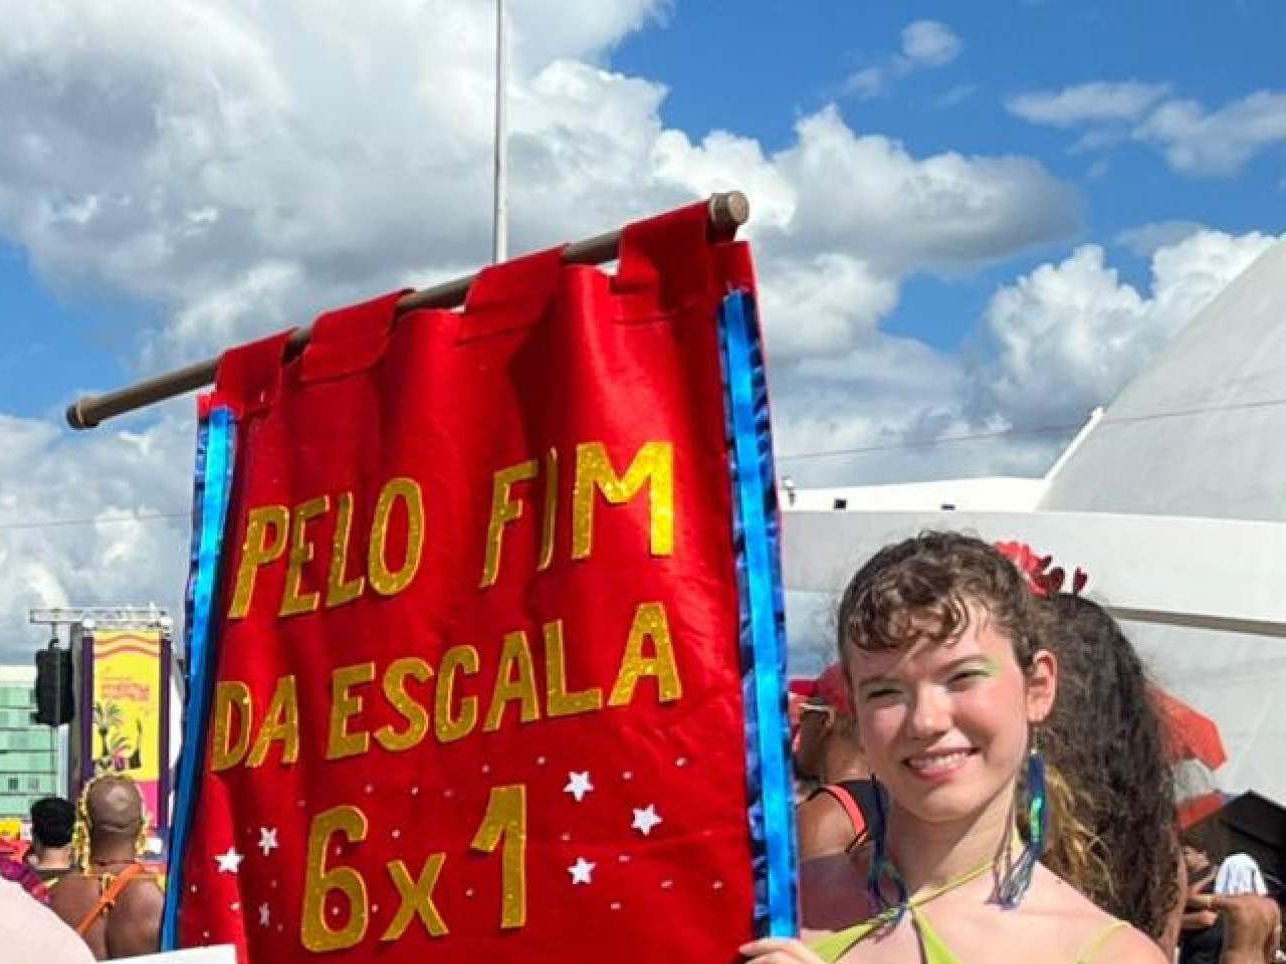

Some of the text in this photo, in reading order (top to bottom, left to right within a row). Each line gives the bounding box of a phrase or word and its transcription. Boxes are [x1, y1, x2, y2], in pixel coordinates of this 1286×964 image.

[227, 441, 674, 619] PELO FIM
[211, 602, 683, 773] DA ESCALA
[300, 784, 527, 953] 6x1
